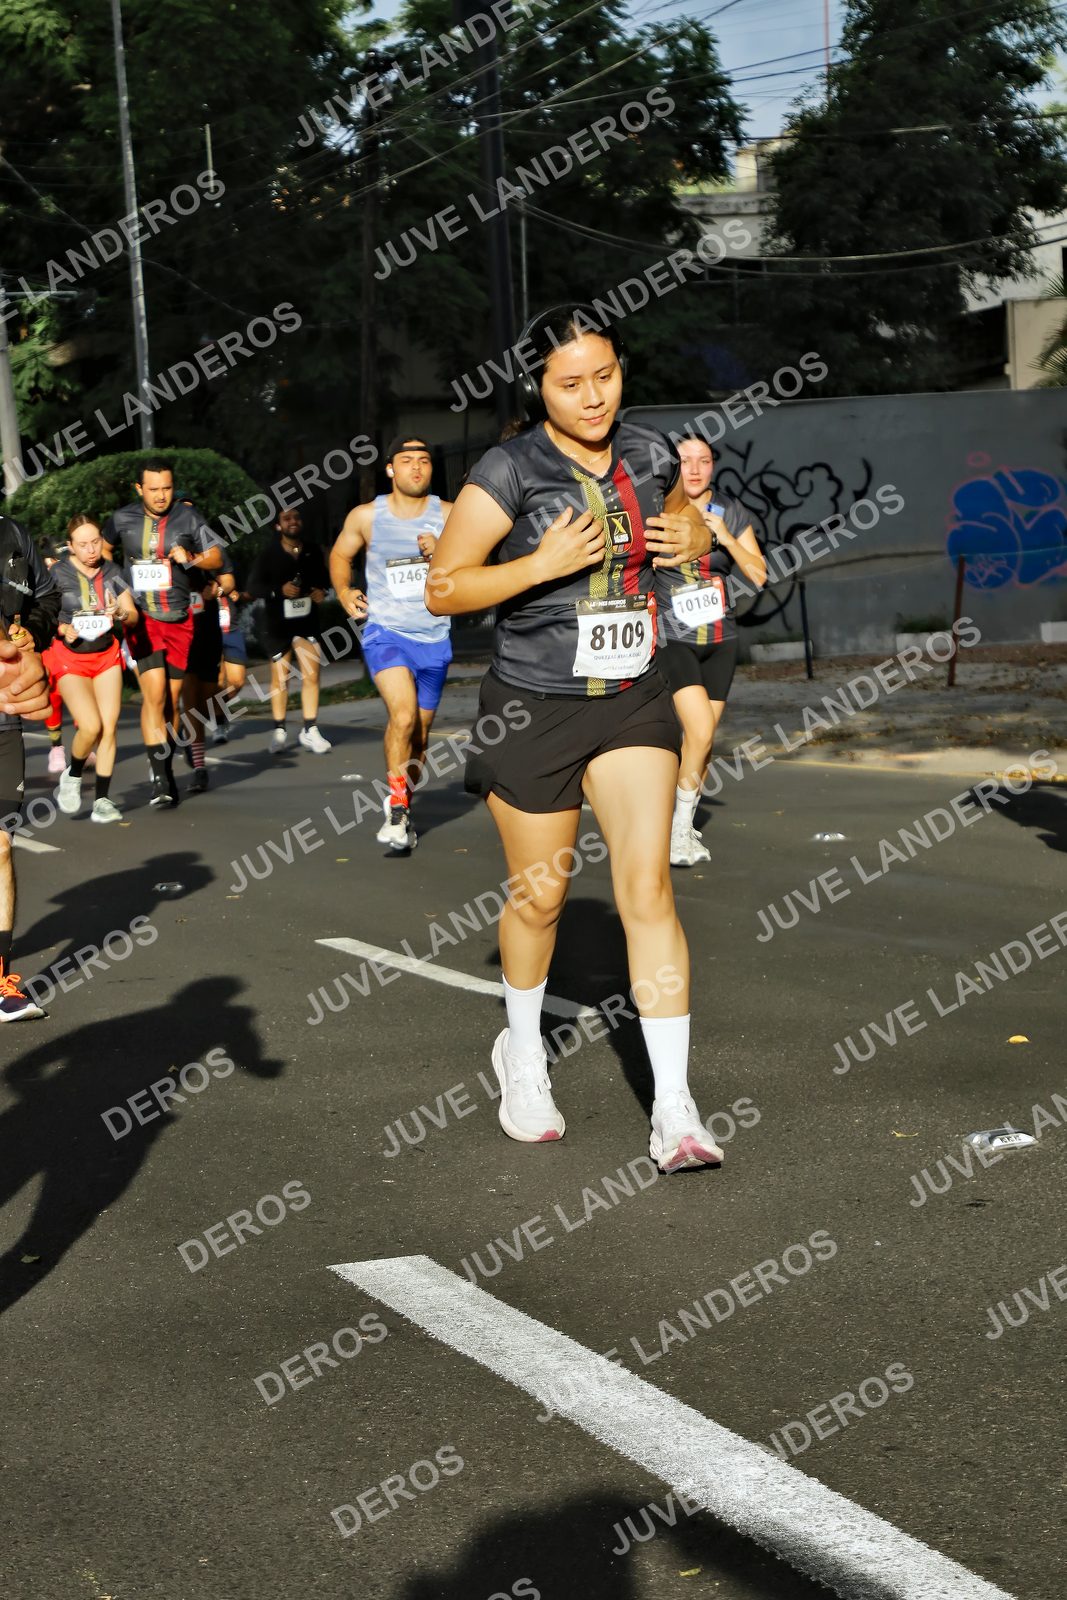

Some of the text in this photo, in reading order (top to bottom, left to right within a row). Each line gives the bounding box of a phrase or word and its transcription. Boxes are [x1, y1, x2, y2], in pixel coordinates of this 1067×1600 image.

[138, 568, 162, 579] 9205
[677, 592, 718, 614] 10186
[590, 620, 645, 651] 8109
